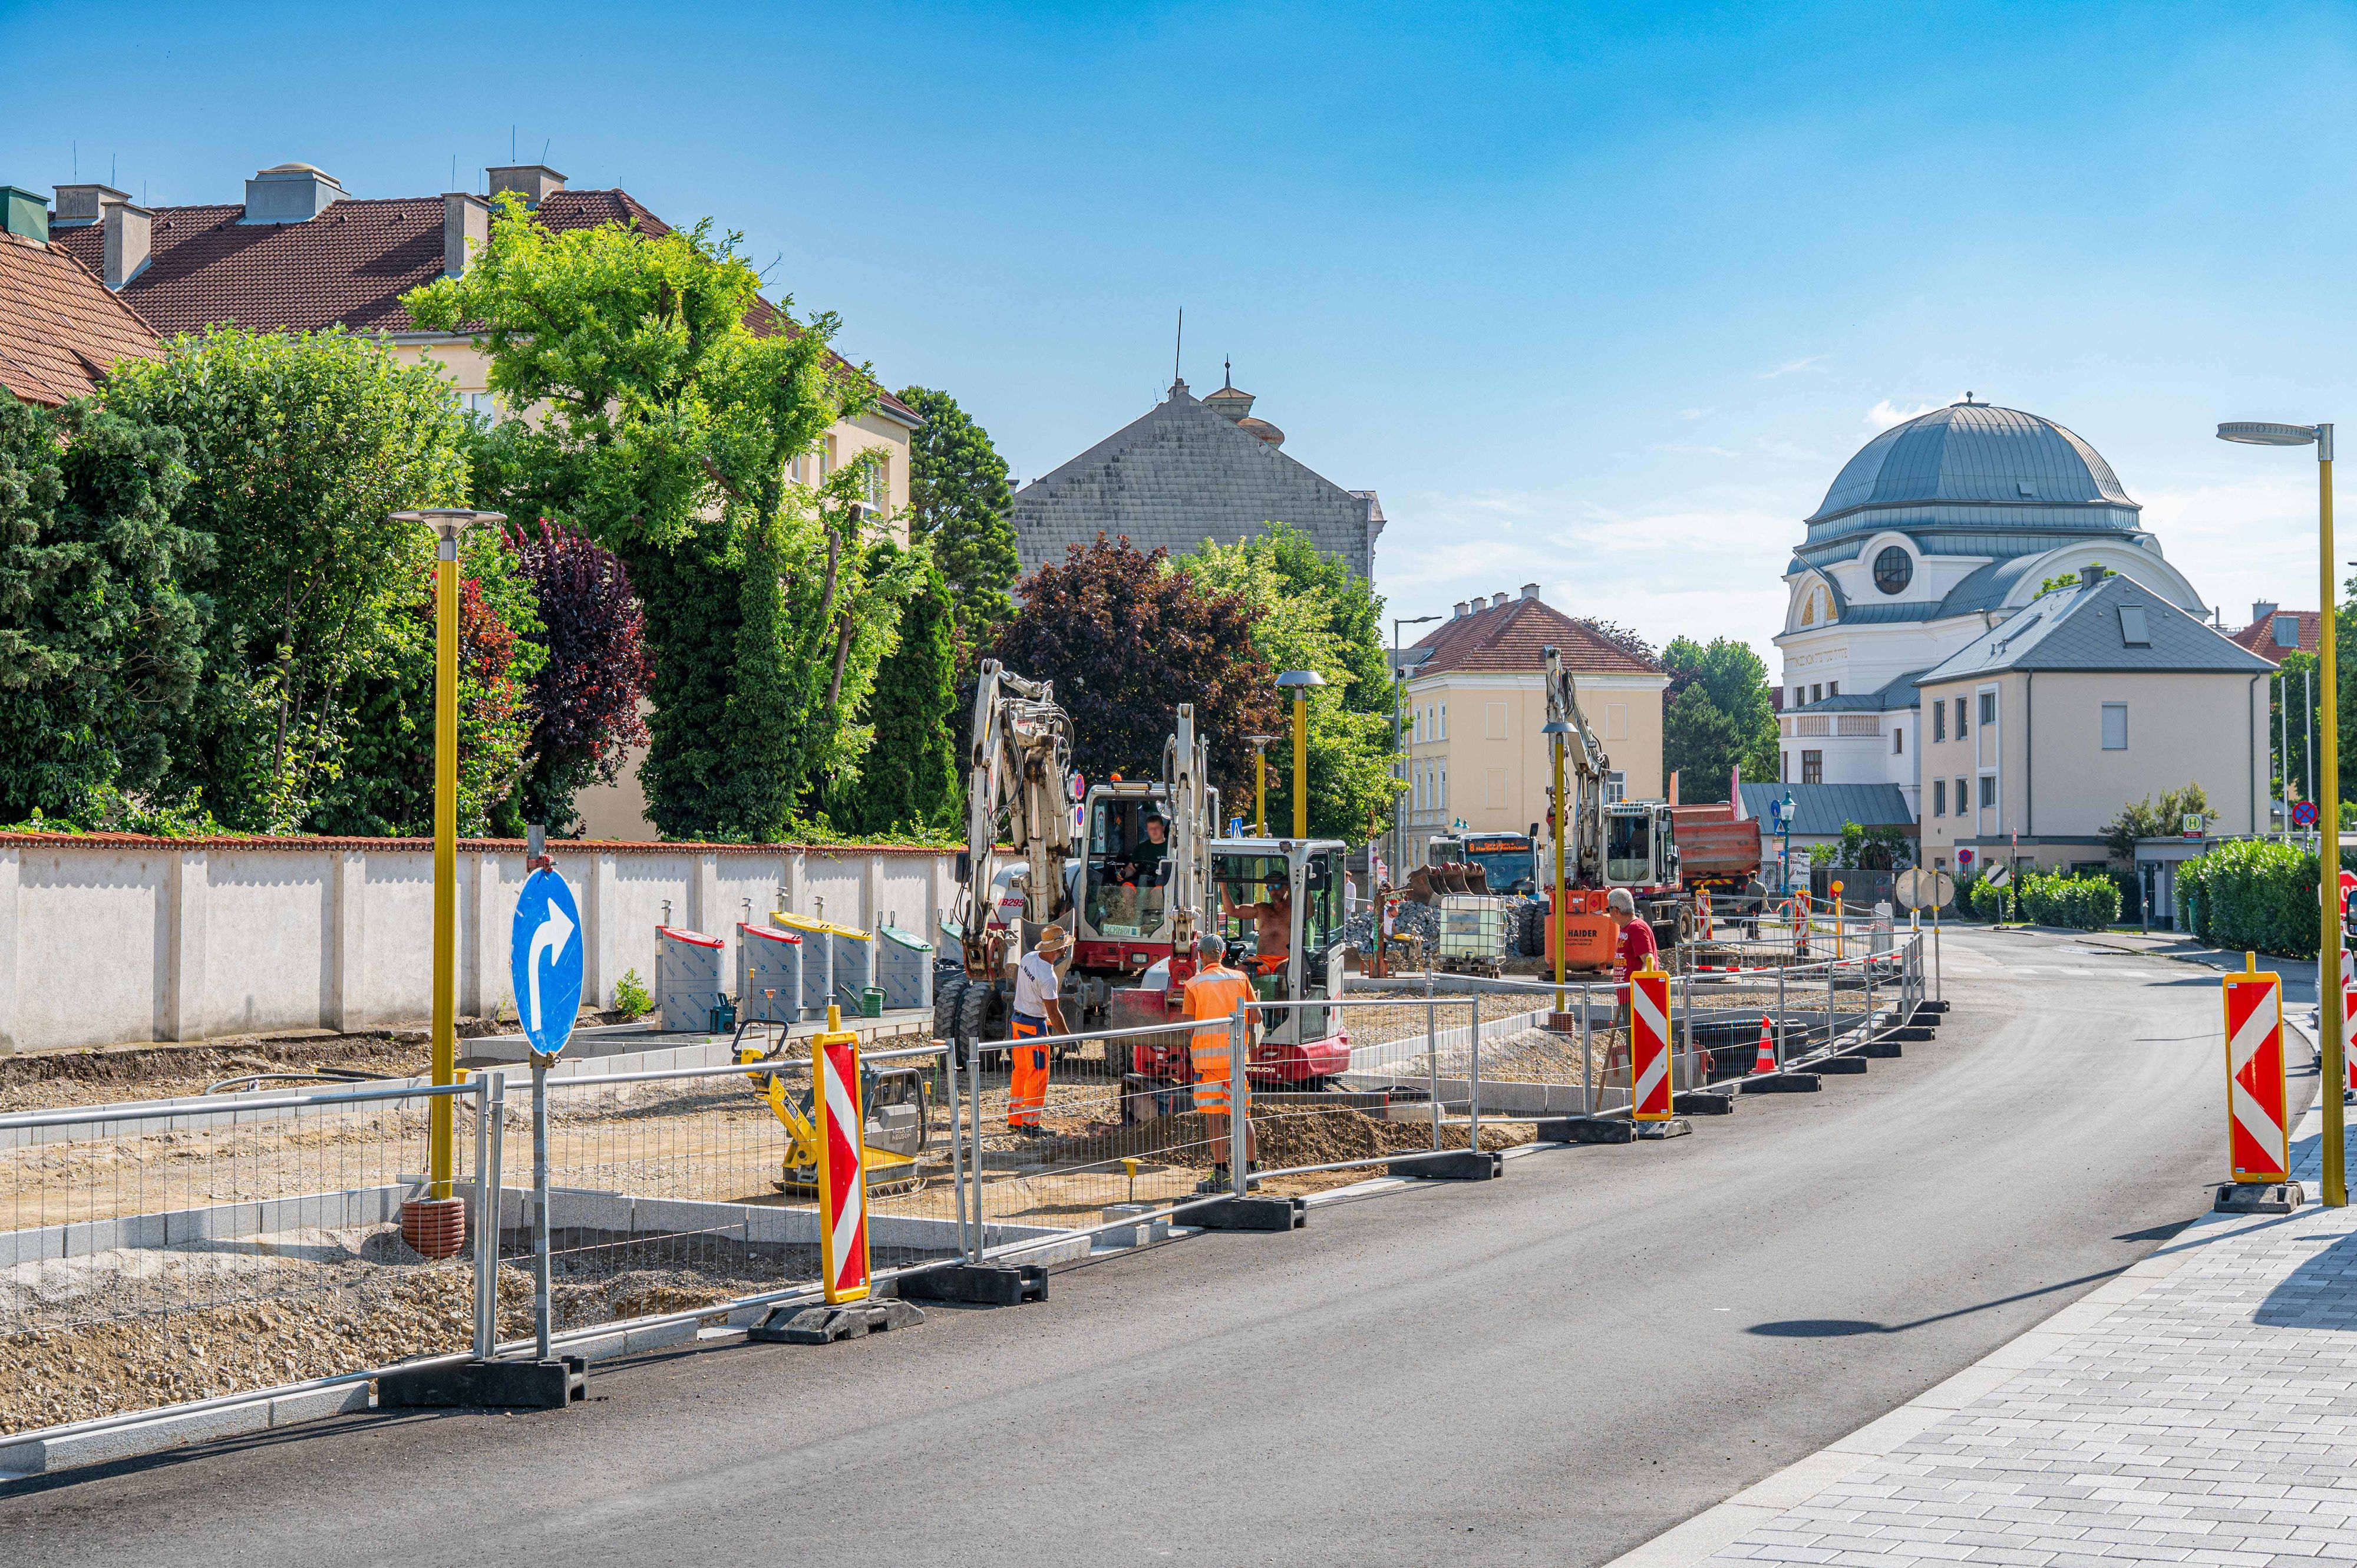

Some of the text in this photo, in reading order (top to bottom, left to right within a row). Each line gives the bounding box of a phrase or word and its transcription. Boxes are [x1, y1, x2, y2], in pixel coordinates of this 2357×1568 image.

[2189, 818, 2197, 827] H
[1469, 843, 1474, 852] 8
[998, 898, 1024, 907] TB295
[1568, 929, 1597, 938] HAIDER
